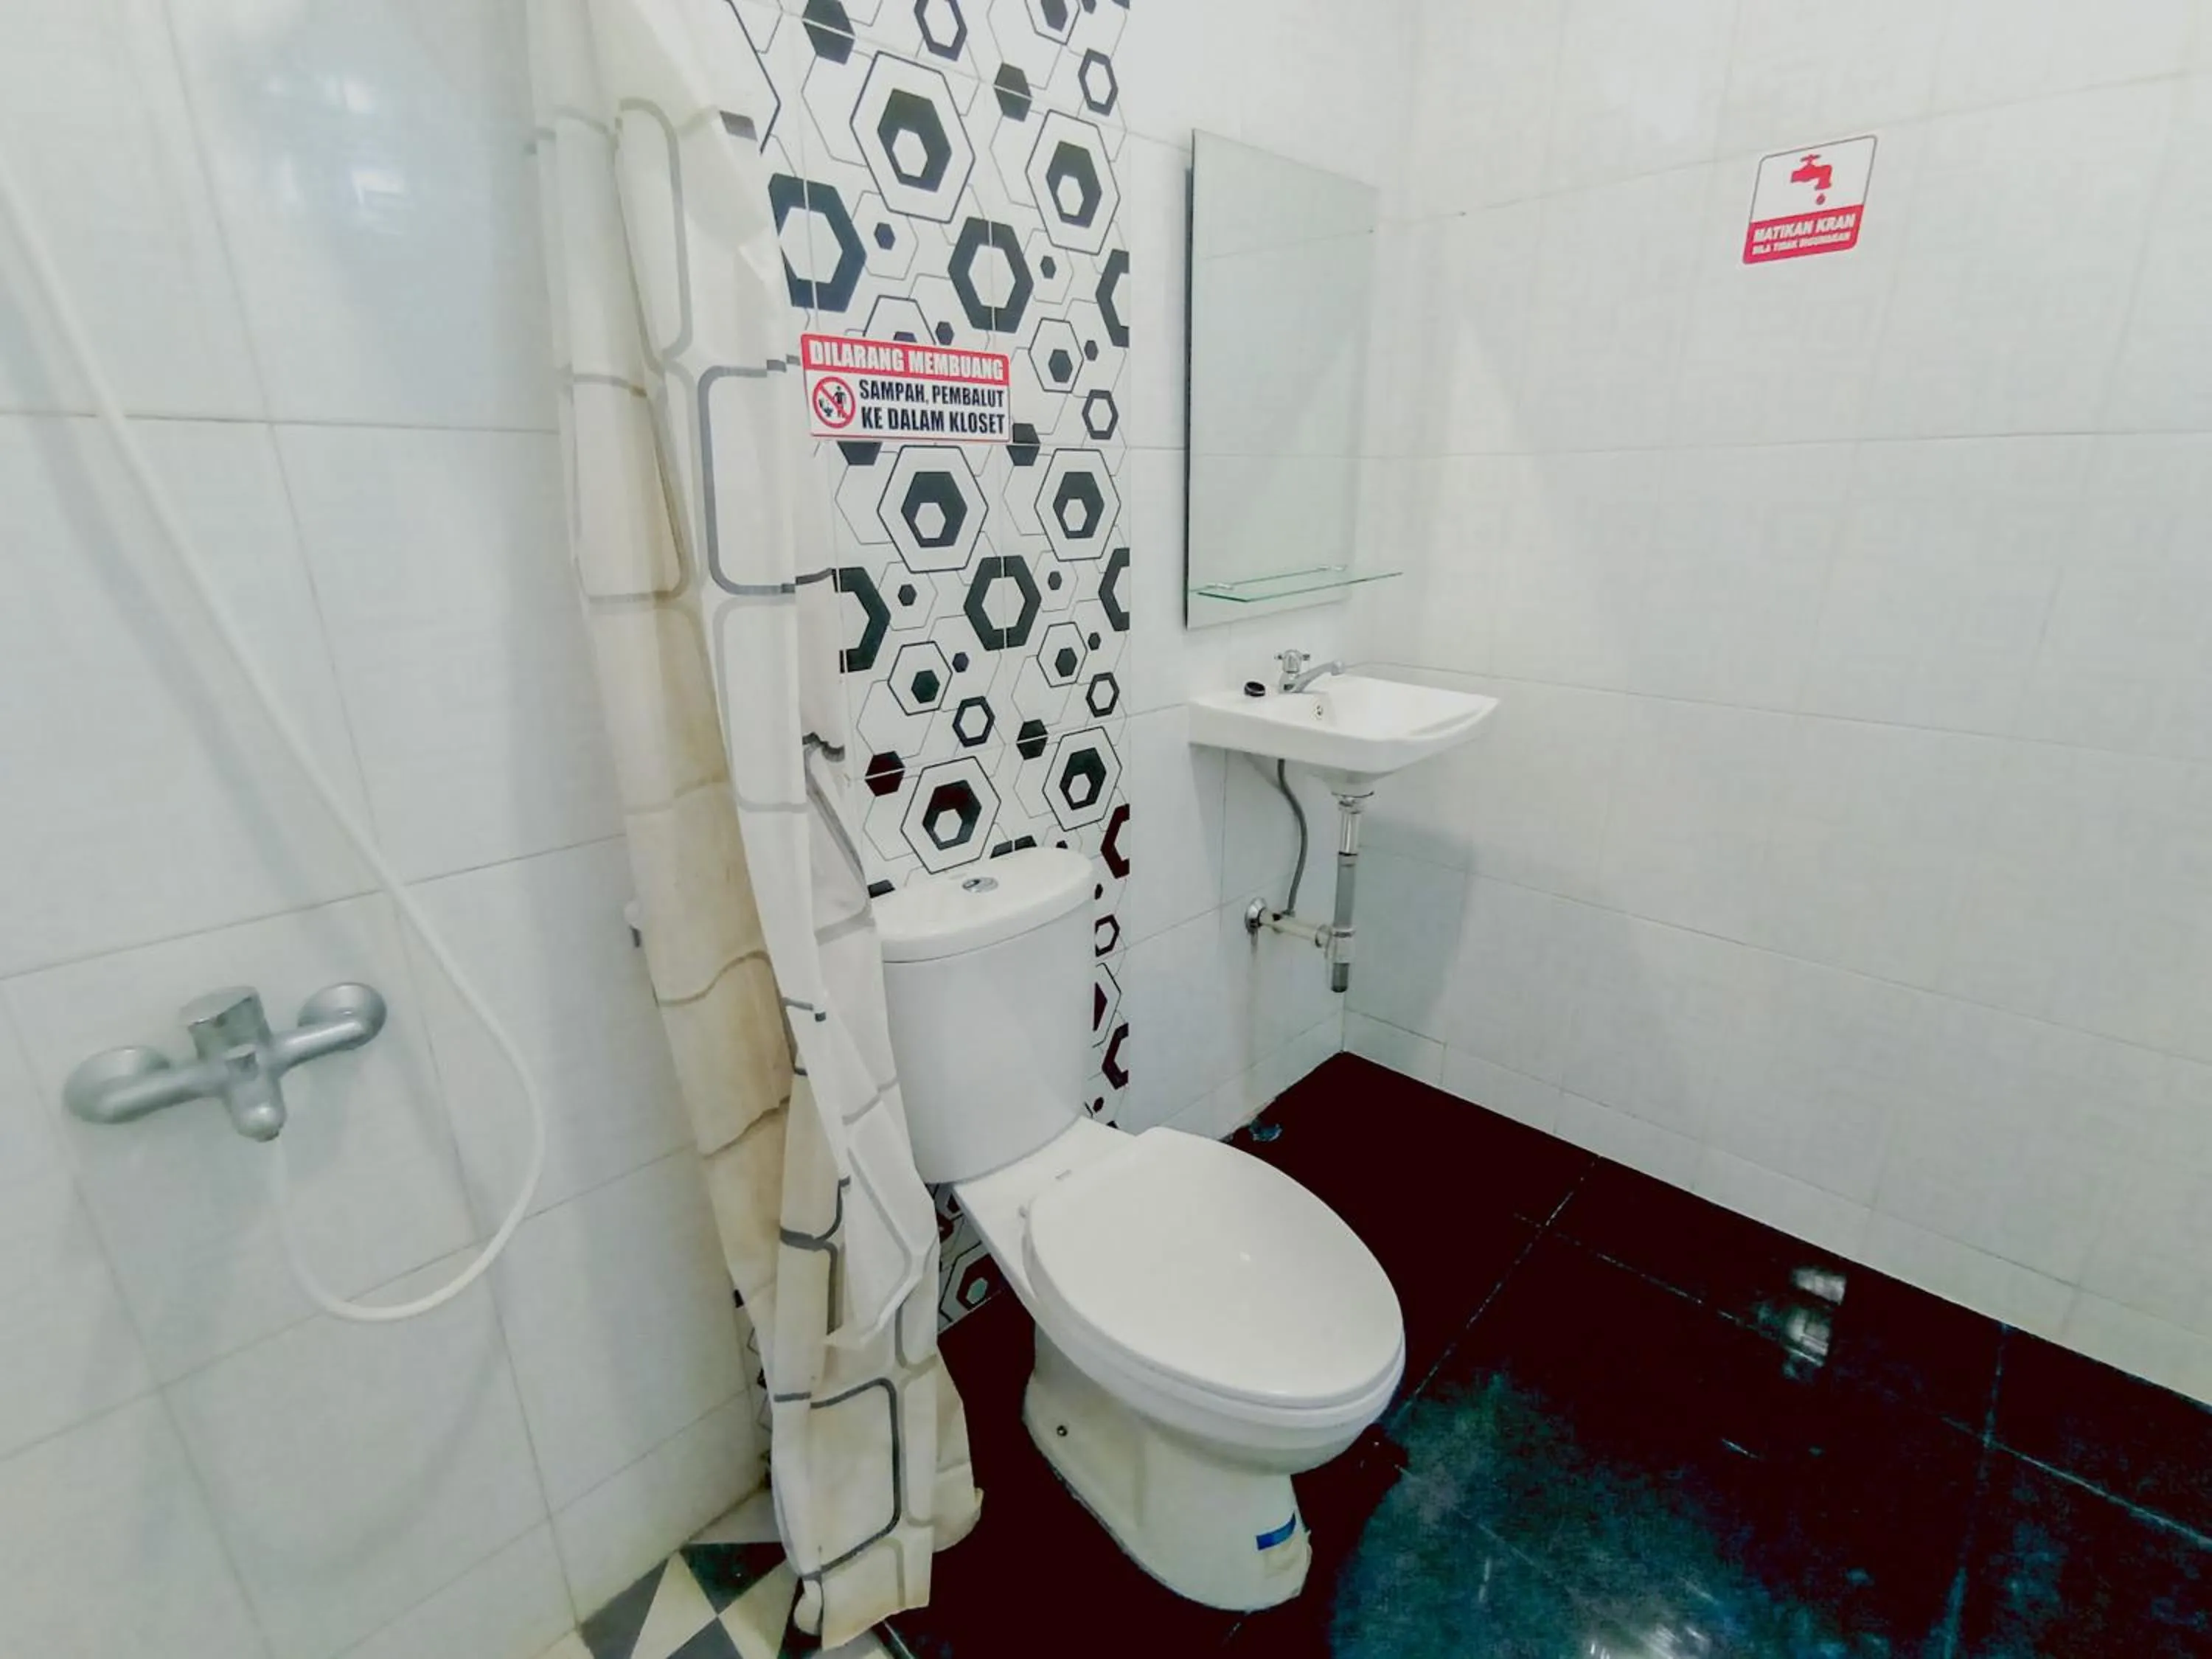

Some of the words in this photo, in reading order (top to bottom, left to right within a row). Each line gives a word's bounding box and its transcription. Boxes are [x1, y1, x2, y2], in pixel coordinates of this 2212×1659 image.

[1753, 220, 1814, 241] MATIKAN
[1815, 214, 1856, 232] KRAN
[809, 340, 905, 372] DILARANG
[908, 350, 1004, 380] MEMBUANG
[859, 378, 929, 405] SAMPAH,
[932, 385, 1004, 408] PEMBALUT
[862, 406, 883, 429] KE
[888, 408, 945, 432] DALAM
[949, 411, 1005, 434] KLOSET
